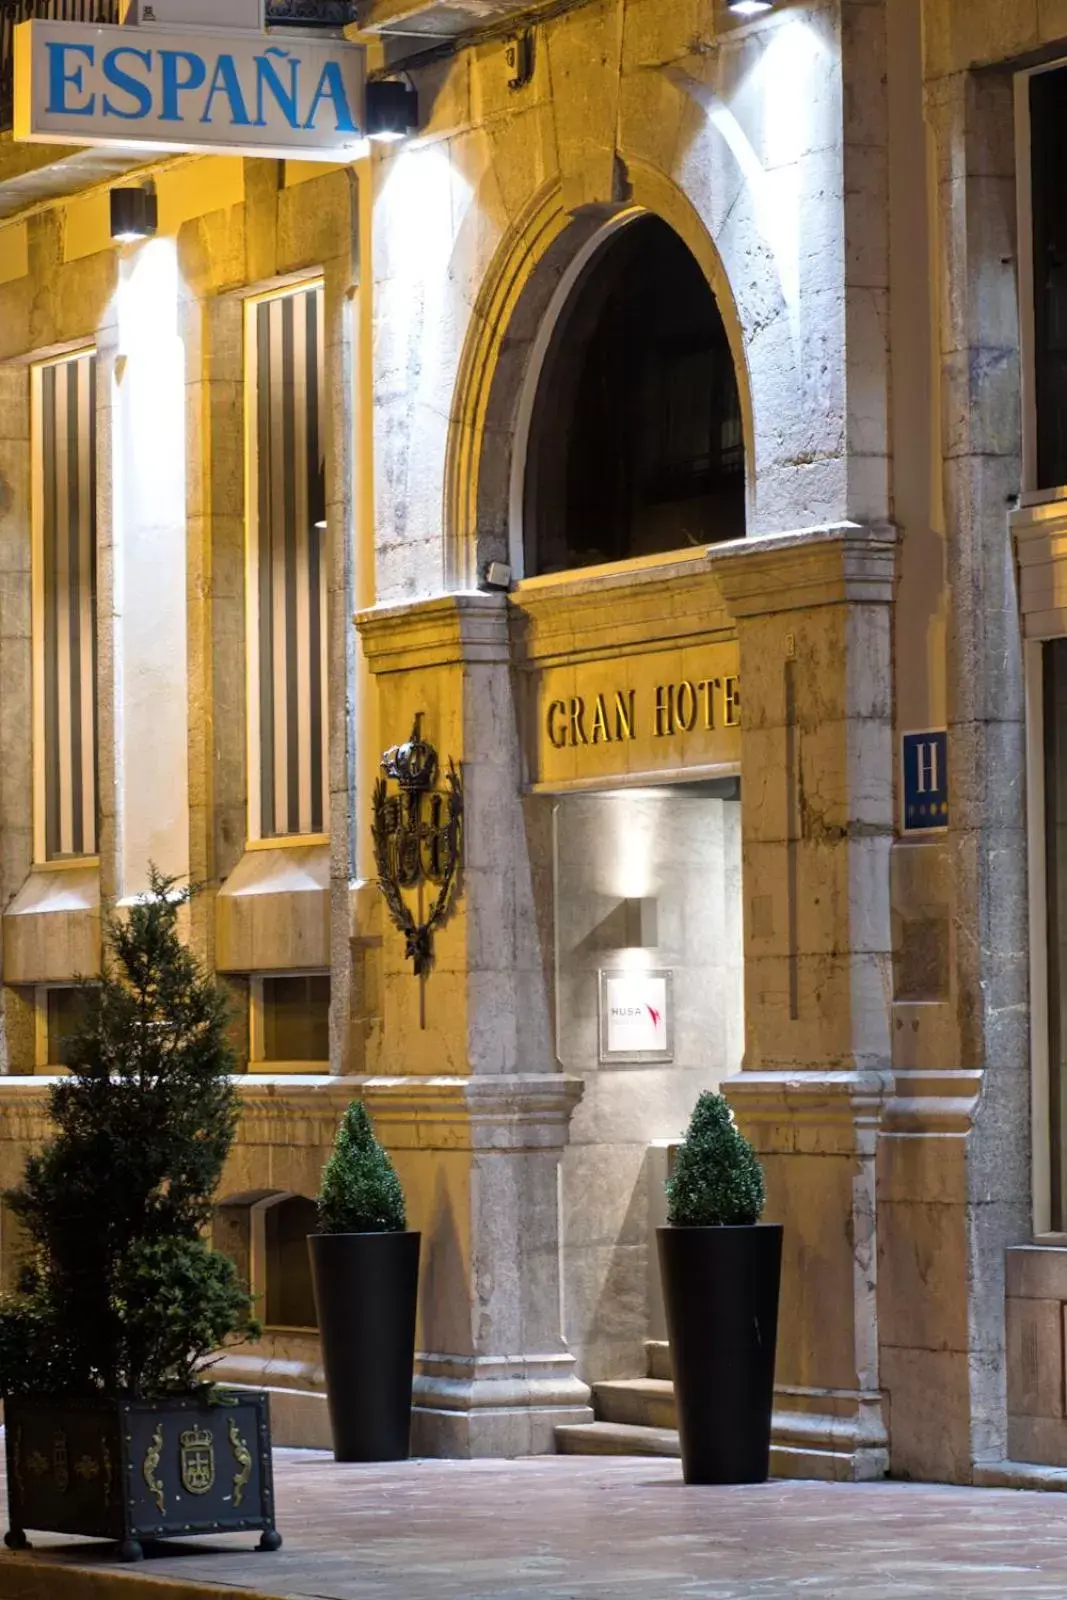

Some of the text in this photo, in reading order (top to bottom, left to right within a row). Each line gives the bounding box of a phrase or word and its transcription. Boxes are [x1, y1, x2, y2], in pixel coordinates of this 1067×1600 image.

[44, 42, 359, 132] ESPAÑA
[546, 675, 741, 749] GRAN HOTE
[916, 741, 939, 793] H
[611, 1007, 641, 1016] HUSA
